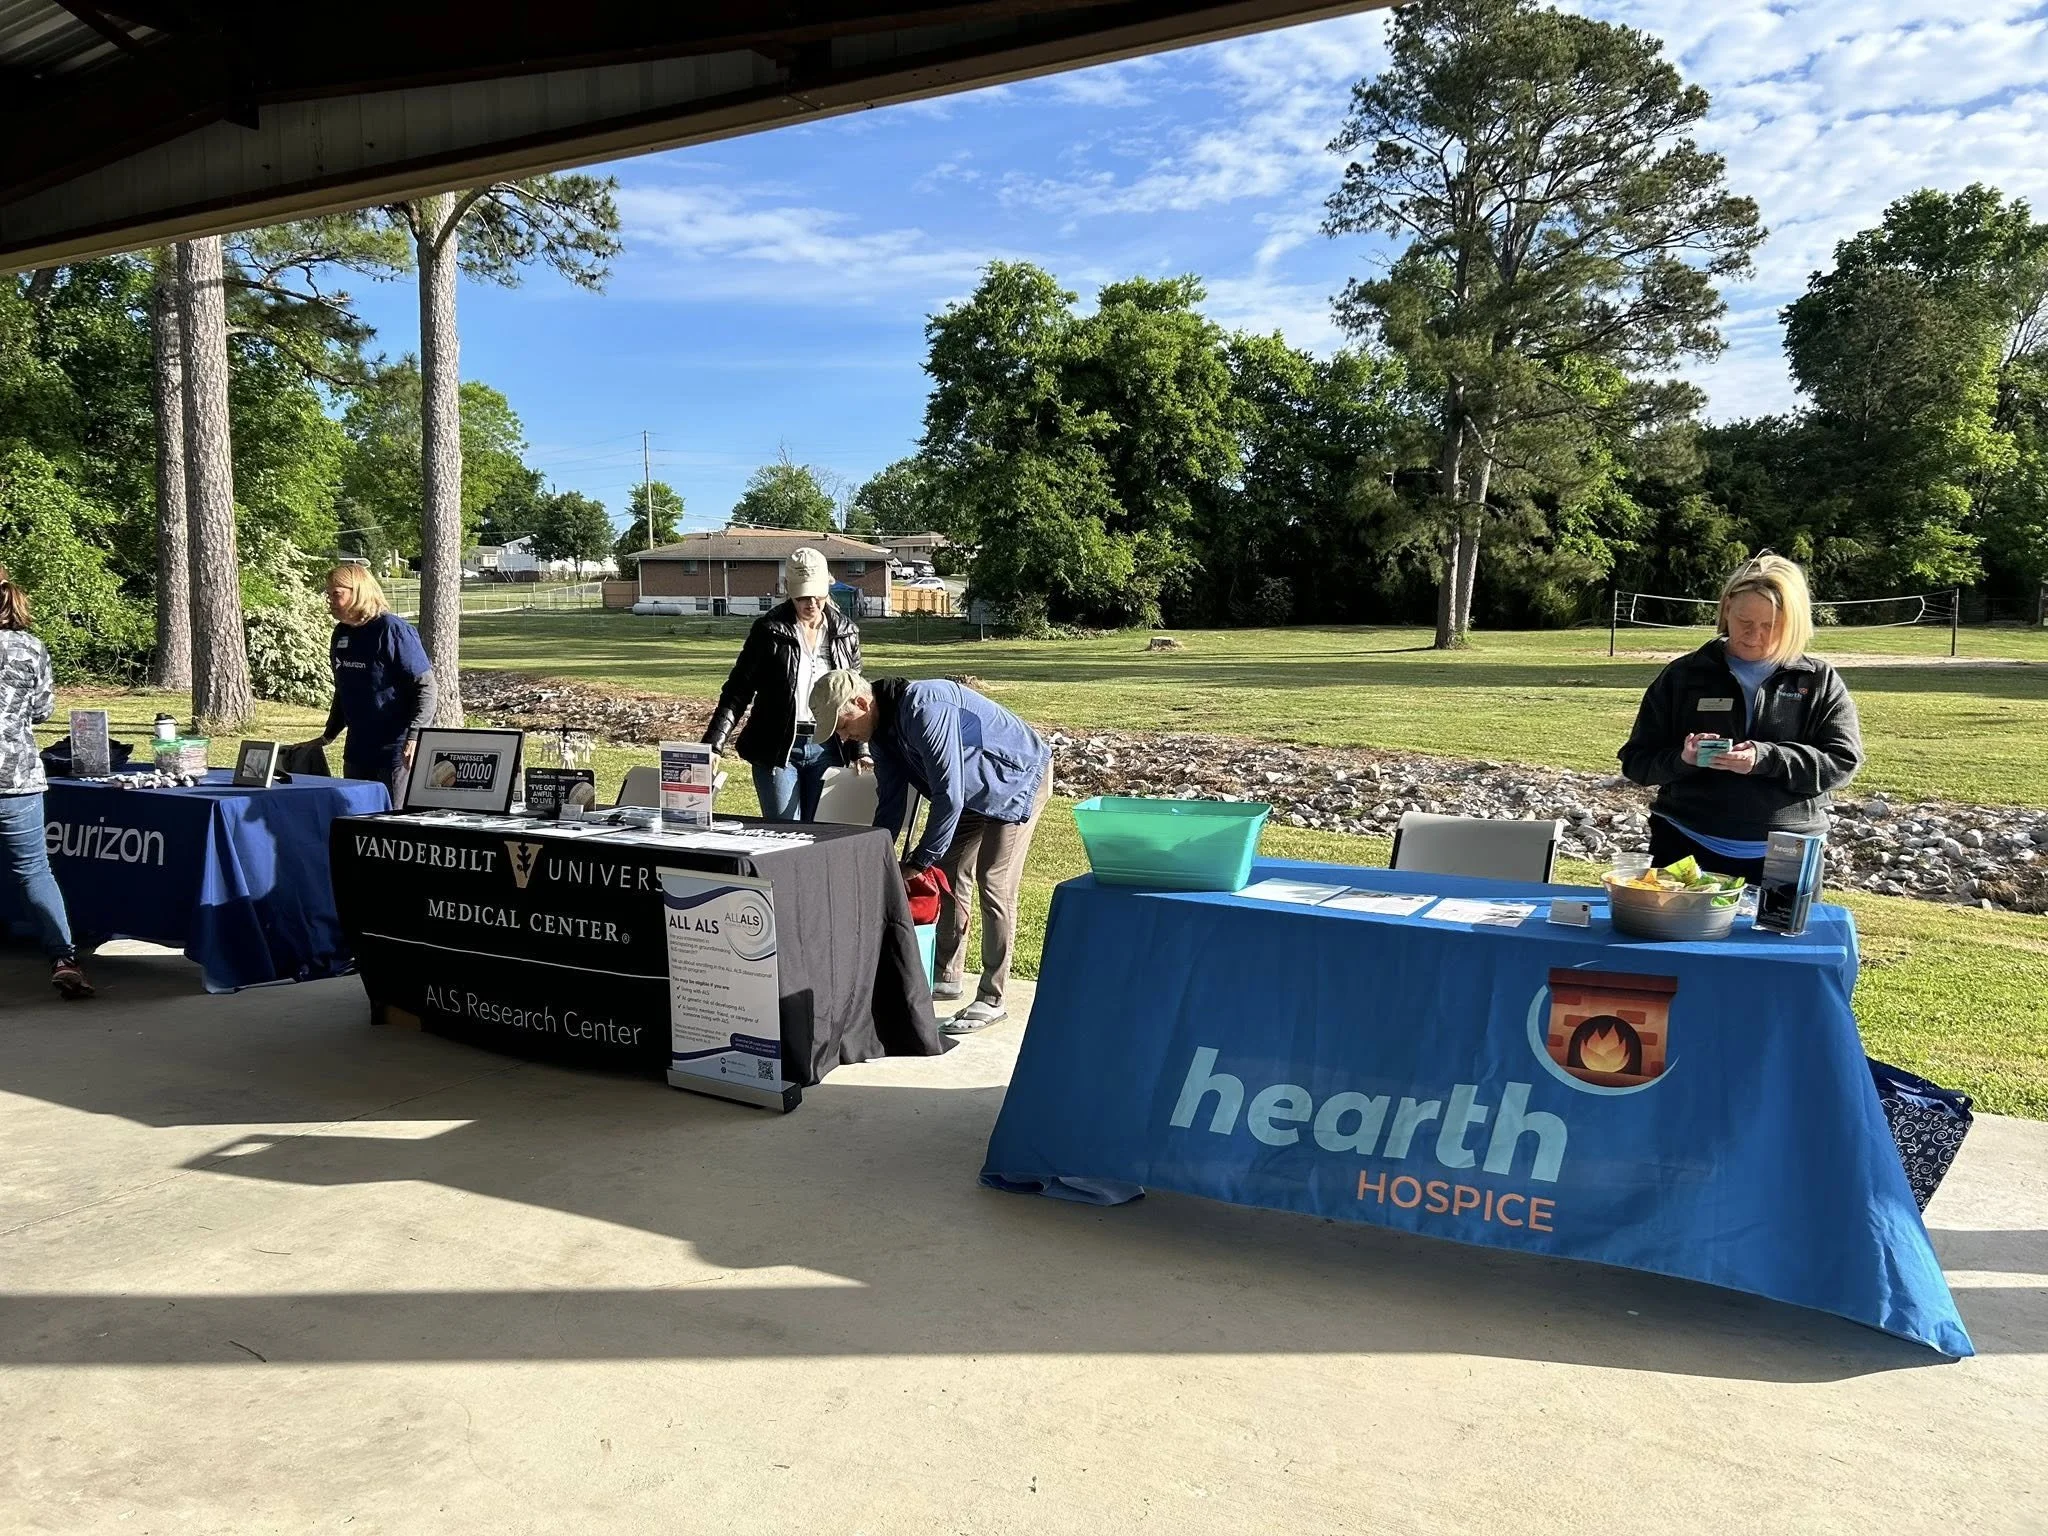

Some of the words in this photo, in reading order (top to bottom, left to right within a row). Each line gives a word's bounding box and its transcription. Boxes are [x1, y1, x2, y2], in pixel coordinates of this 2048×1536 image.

[449, 754, 484, 762] TENNESSEE
[543, 784, 556, 792] GOT
[355, 835, 497, 872] VANDERBILT
[427, 898, 521, 929] MEDICAL
[669, 914, 691, 930] ALL
[694, 917, 719, 935] ALS
[426, 984, 461, 1013] ALS
[466, 992, 557, 1033] Research
[563, 1010, 642, 1045] Center
[1169, 1046, 1568, 1183] hearth
[1357, 1169, 1556, 1232] HOSPICE
